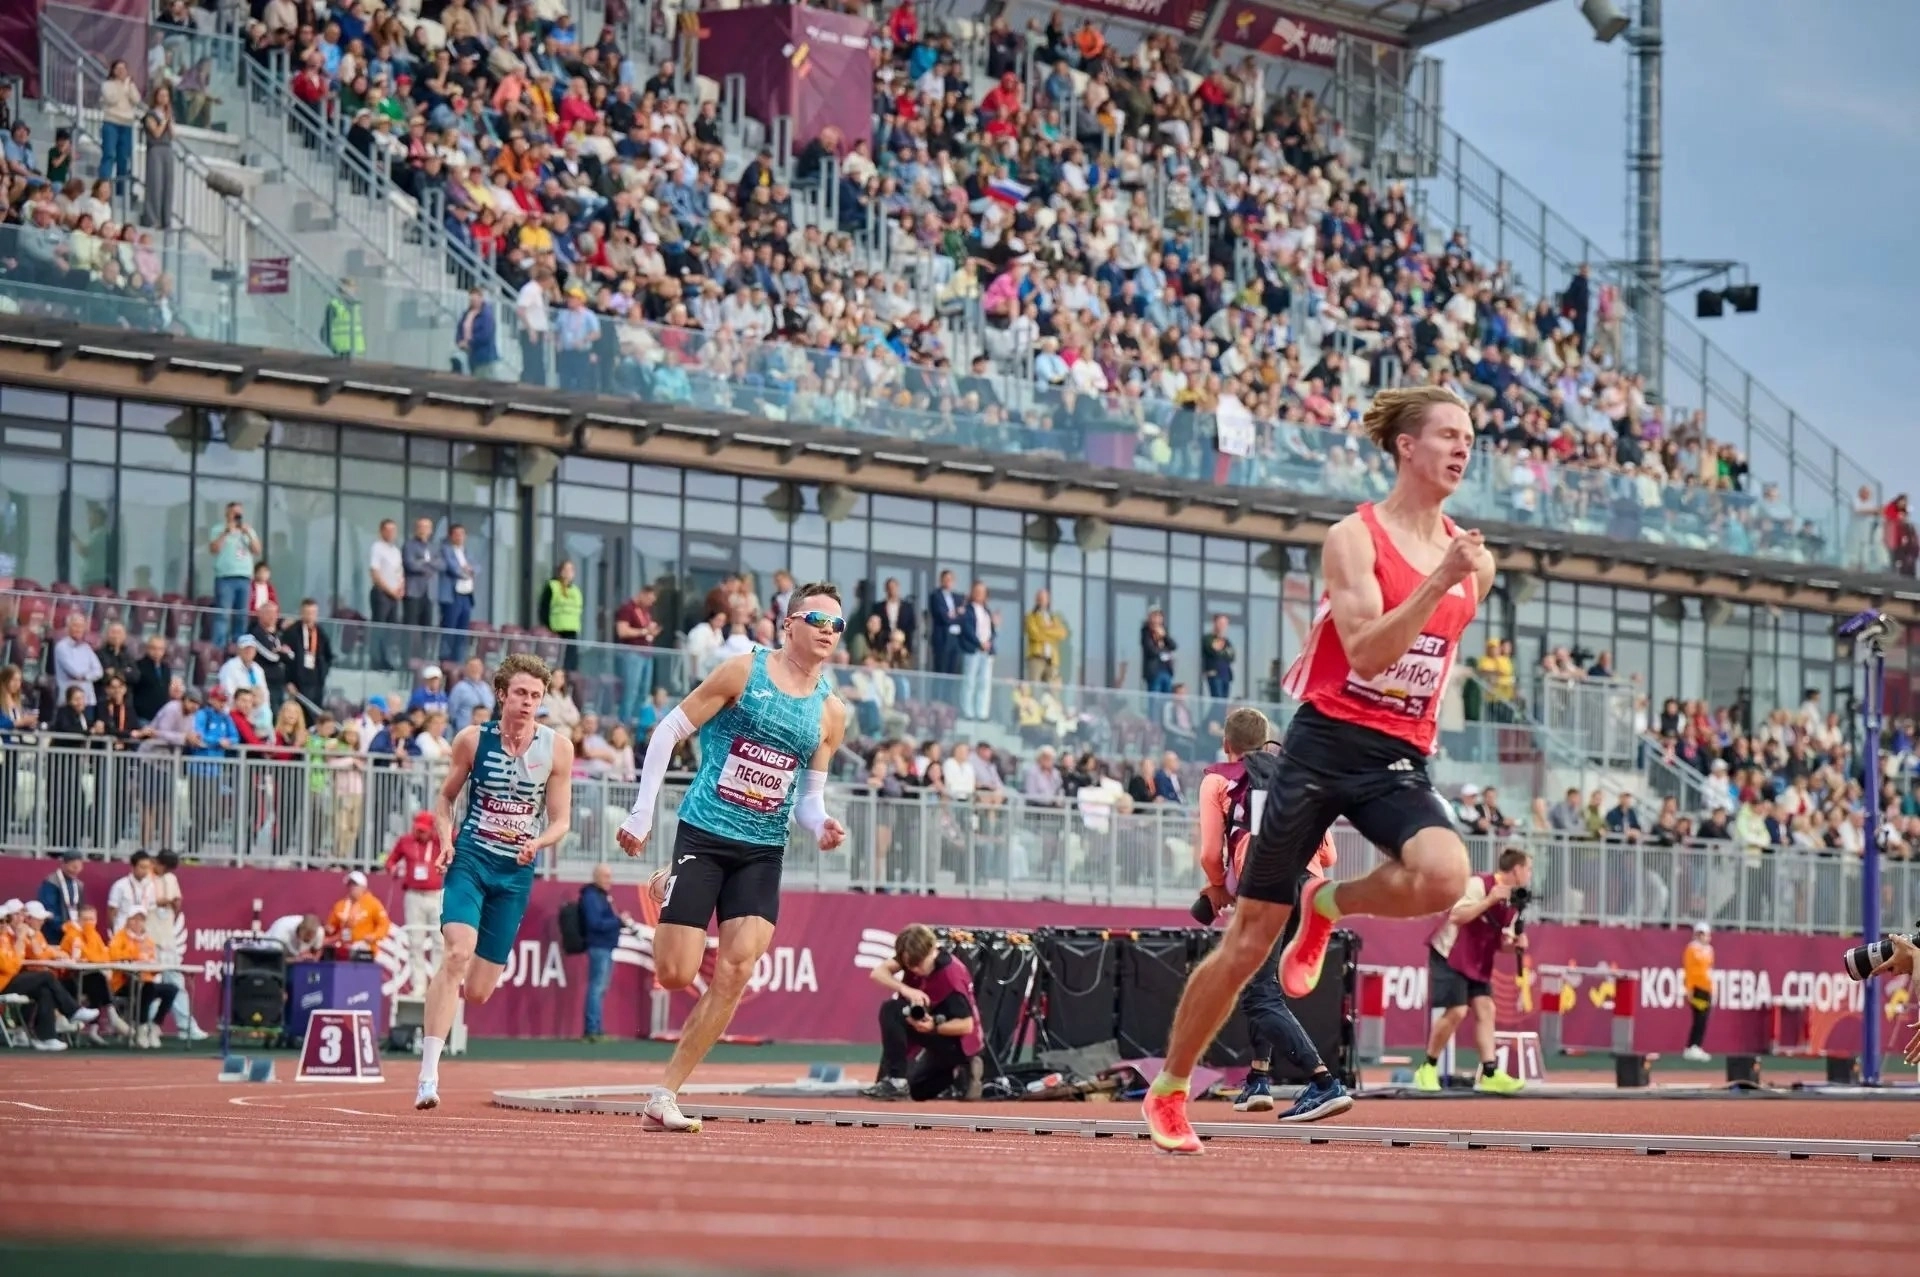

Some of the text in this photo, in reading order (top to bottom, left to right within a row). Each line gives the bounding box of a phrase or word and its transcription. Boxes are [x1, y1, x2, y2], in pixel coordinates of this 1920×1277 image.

[1413, 635, 1445, 655] BET
[1385, 663, 1440, 689] РИЛЮК
[739, 742, 794, 769] FONBET
[734, 764, 782, 790] ПЕСКОВ
[487, 799, 530, 814] FONBET
[747, 947, 818, 992] ФЛА
[1382, 965, 1429, 1010] FON
[1641, 966, 1772, 1010] КОРЛЕВА
[319, 1025, 343, 1065] 3
[361, 1026, 374, 1064] 3
[1526, 1046, 1538, 1078] 1
